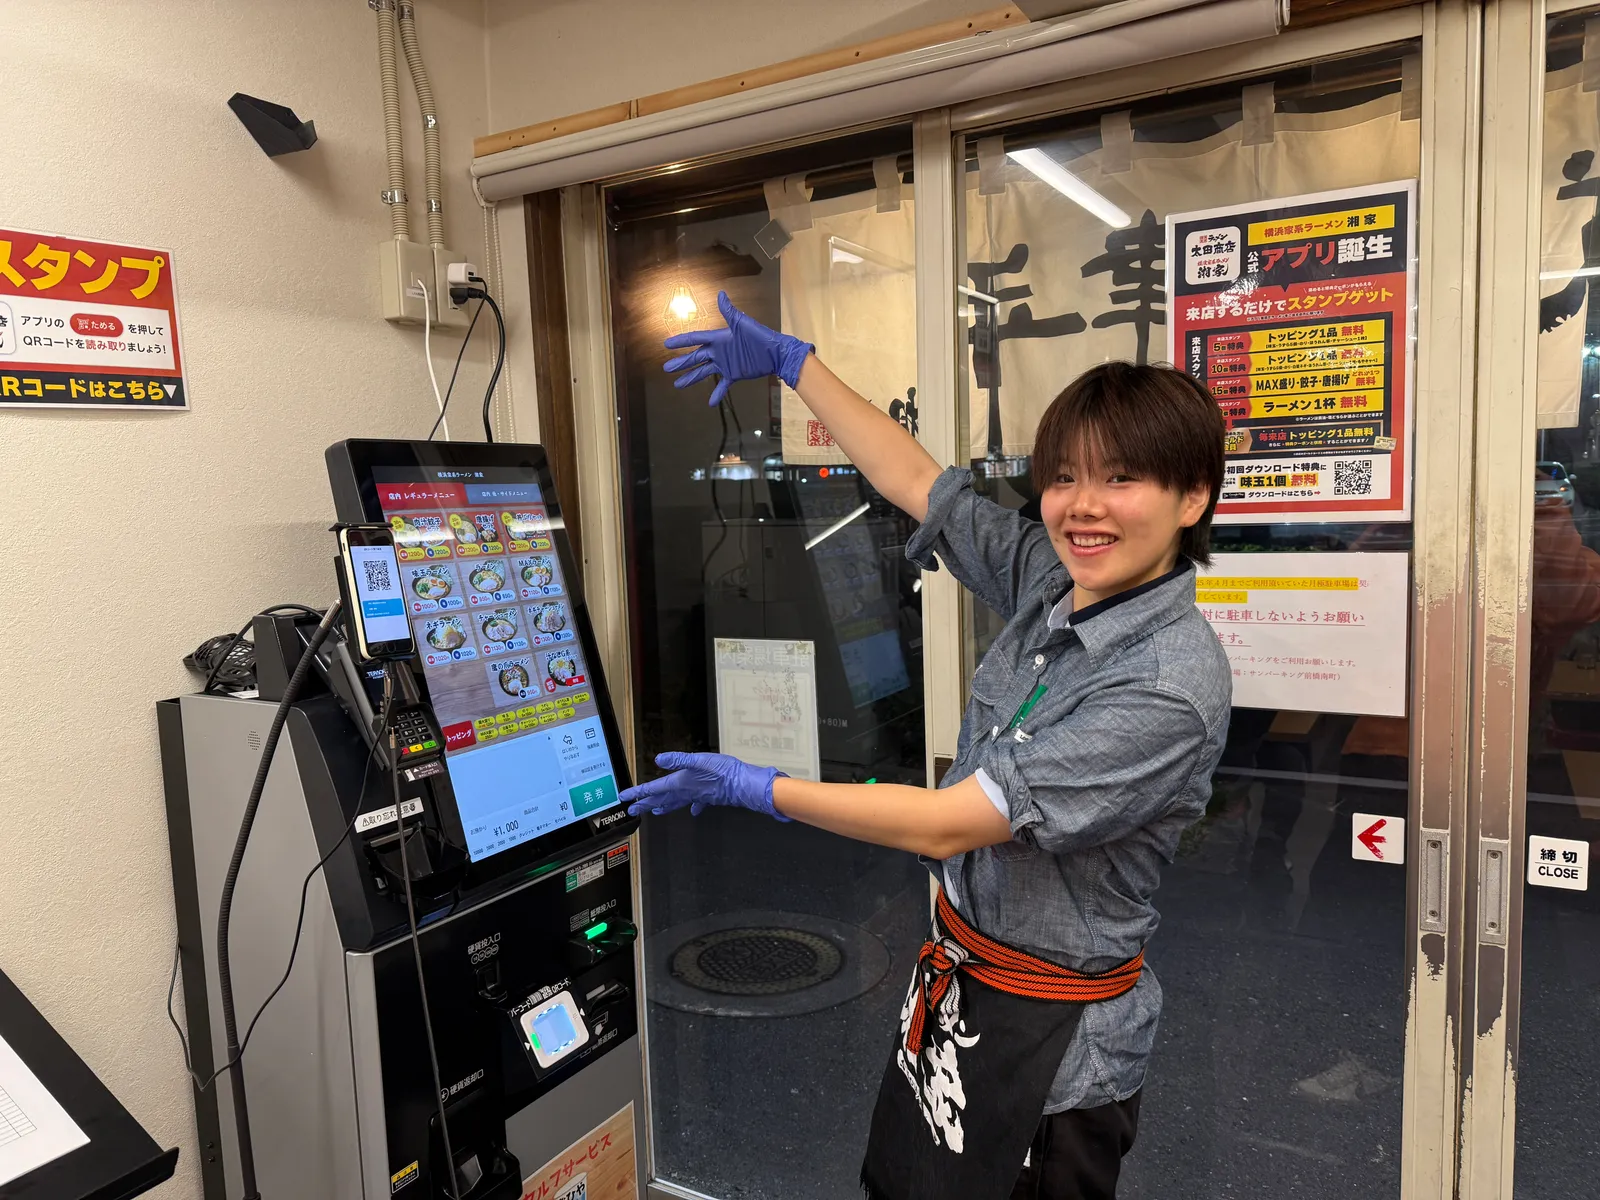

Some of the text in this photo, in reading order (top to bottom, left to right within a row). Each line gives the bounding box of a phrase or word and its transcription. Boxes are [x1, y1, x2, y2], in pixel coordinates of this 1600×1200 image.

[1264, 213, 1377, 238] 横浜家系ラーメン 湘家
[1261, 234, 1393, 272] アプリ誕生
[0, 240, 165, 299] スタンプ
[1247, 251, 1259, 274] 公式
[1185, 287, 1394, 322] 来店するだけでスタンプゲット
[21, 316, 64, 328] アプリの
[91, 321, 116, 332] ためる
[128, 324, 164, 336] を押して
[1268, 324, 1364, 343] トッピング1品 無料
[1268, 348, 1364, 365] トッピング1品 無料
[1211, 364, 1247, 374] 10個特典
[0, 376, 164, 400] Rコードはこちら
[1256, 374, 1350, 391] MAX盛り・餃子・唐揚げ
[1356, 376, 1376, 387] 無料
[1211, 386, 1247, 396] 15個特典
[1263, 395, 1367, 413] ラーメン1杯 無料
[1220, 408, 1247, 417] 個特典
[1259, 427, 1374, 441] 毎来店 トッピング1品無料
[1224, 463, 1327, 475] 初回ダウンロード特典に
[1240, 475, 1286, 488] 味玉1個
[1291, 474, 1317, 486] 無料
[1248, 490, 1313, 498] ダウンロードはこちら
[412, 567, 448, 577] 味玉ラーメン
[1203, 608, 1364, 623] 対に駐車しないようお願い
[426, 618, 462, 629] ネギラーメン
[446, 729, 472, 742] トッピング
[583, 788, 604, 804] 発券
[369, 805, 410, 824] 取り忘れ意
[601, 811, 626, 826] TERAOKA
[493, 820, 519, 837] ¥1,000
[1540, 848, 1577, 863] 締切
[1538, 865, 1579, 879] CLOSE
